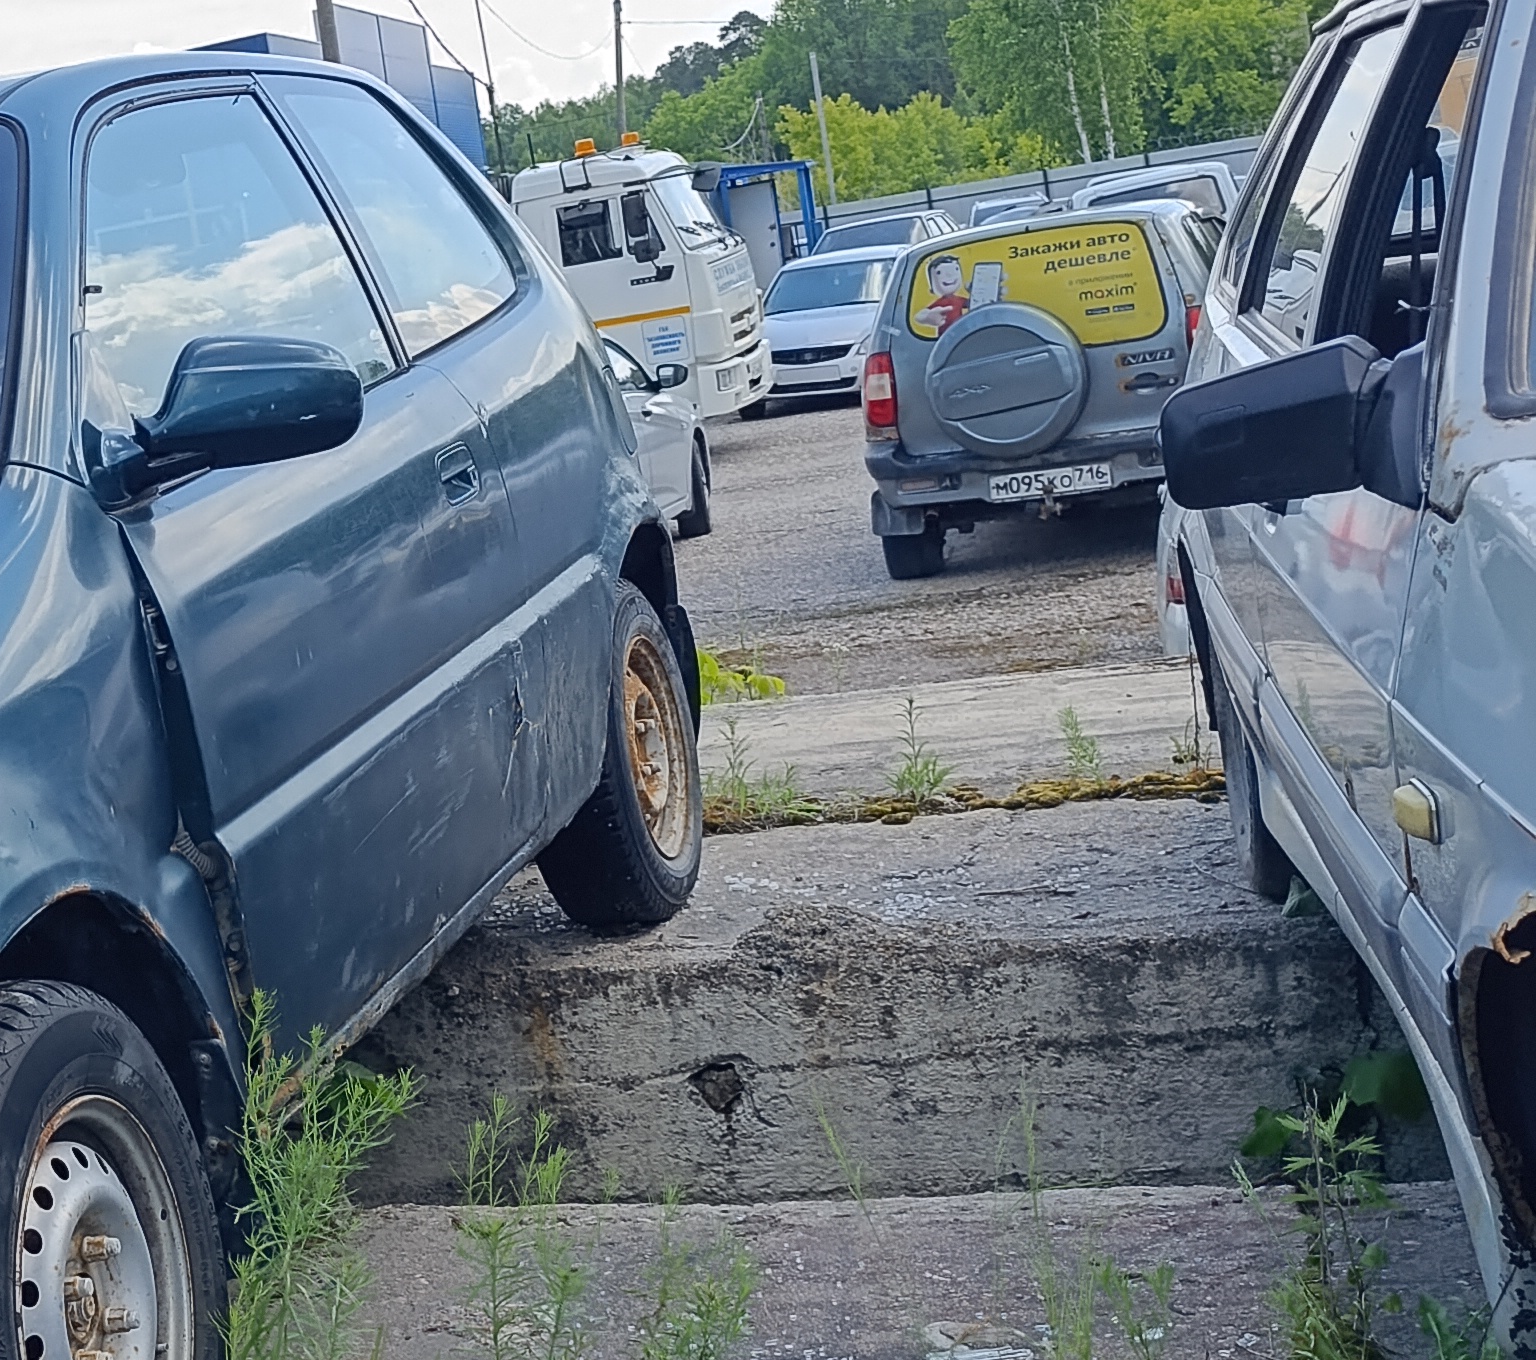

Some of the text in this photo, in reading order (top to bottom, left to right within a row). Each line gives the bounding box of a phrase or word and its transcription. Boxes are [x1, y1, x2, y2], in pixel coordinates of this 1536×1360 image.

[1008, 232, 1130, 259] Закажи авто
[1044, 249, 1132, 274] дешевле
[1079, 283, 1135, 301] maxim
[1124, 350, 1170, 364] NIVA
[1074, 465, 1105, 482] 716
